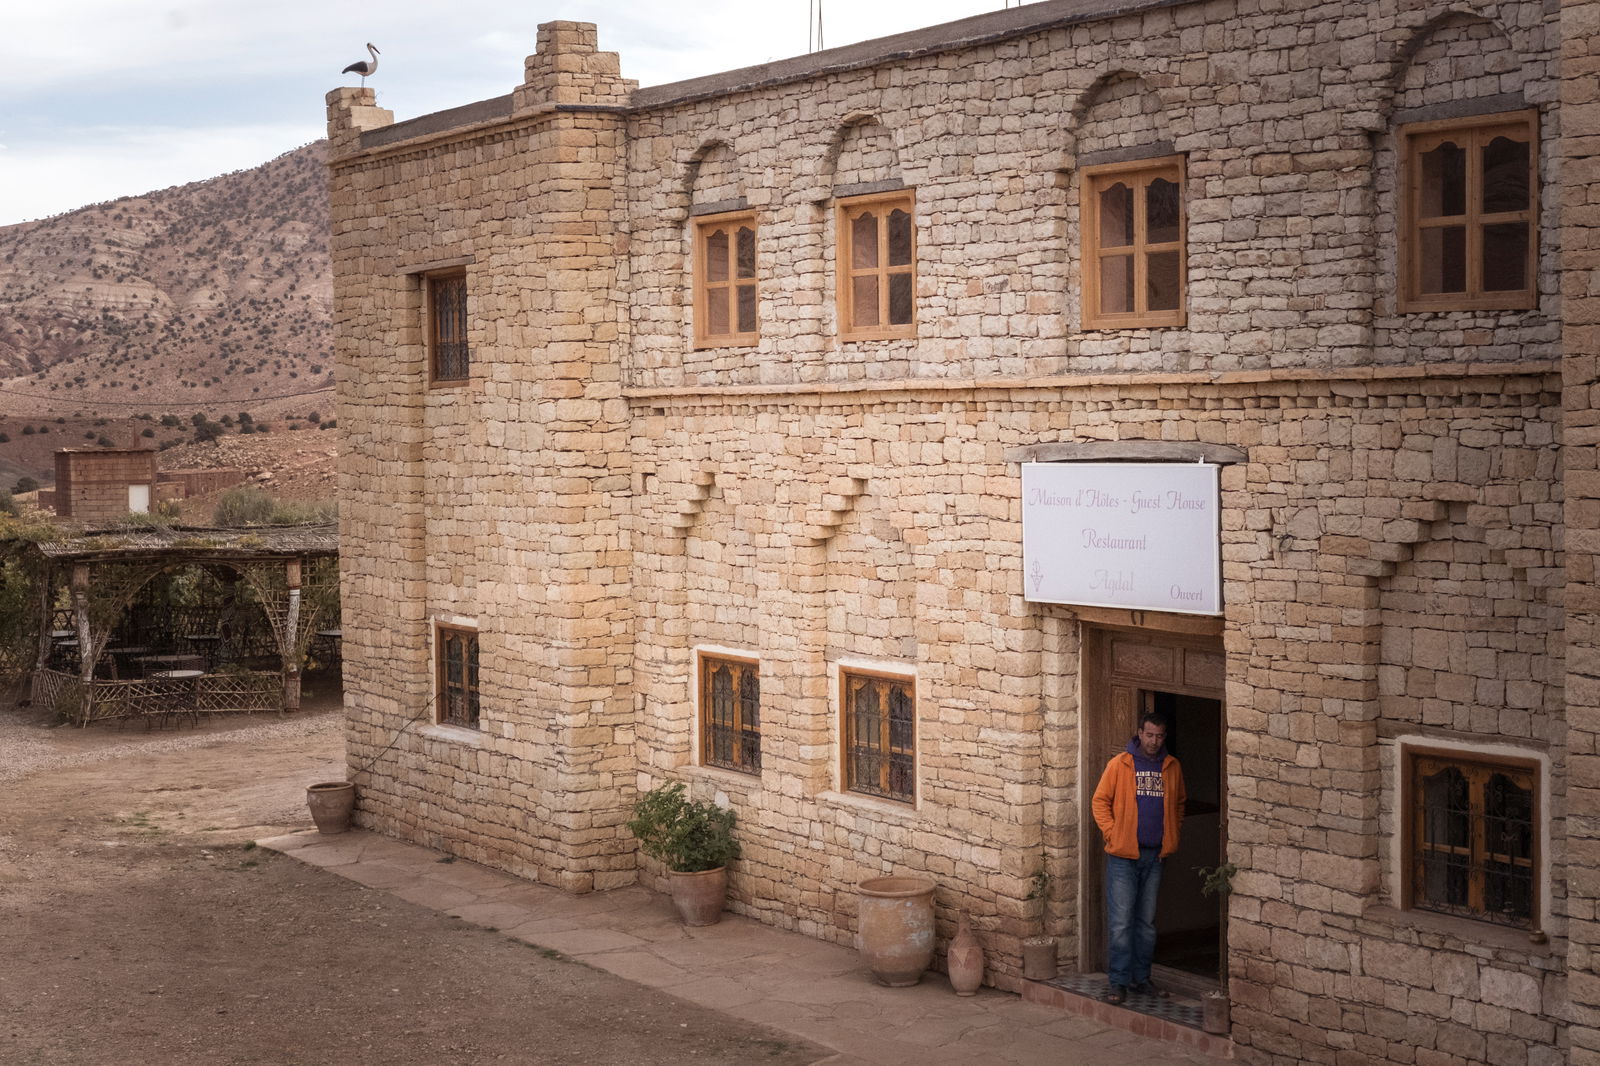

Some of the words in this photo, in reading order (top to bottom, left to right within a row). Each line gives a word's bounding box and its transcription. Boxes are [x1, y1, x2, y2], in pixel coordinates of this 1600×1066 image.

[1028, 488, 1072, 507] Maison
[1131, 490, 1161, 514] Guest
[1166, 490, 1206, 511] House
[1081, 528, 1147, 551] Restaurant
[1088, 568, 1135, 598] Agdal
[1170, 583, 1203, 601] Ouvert
